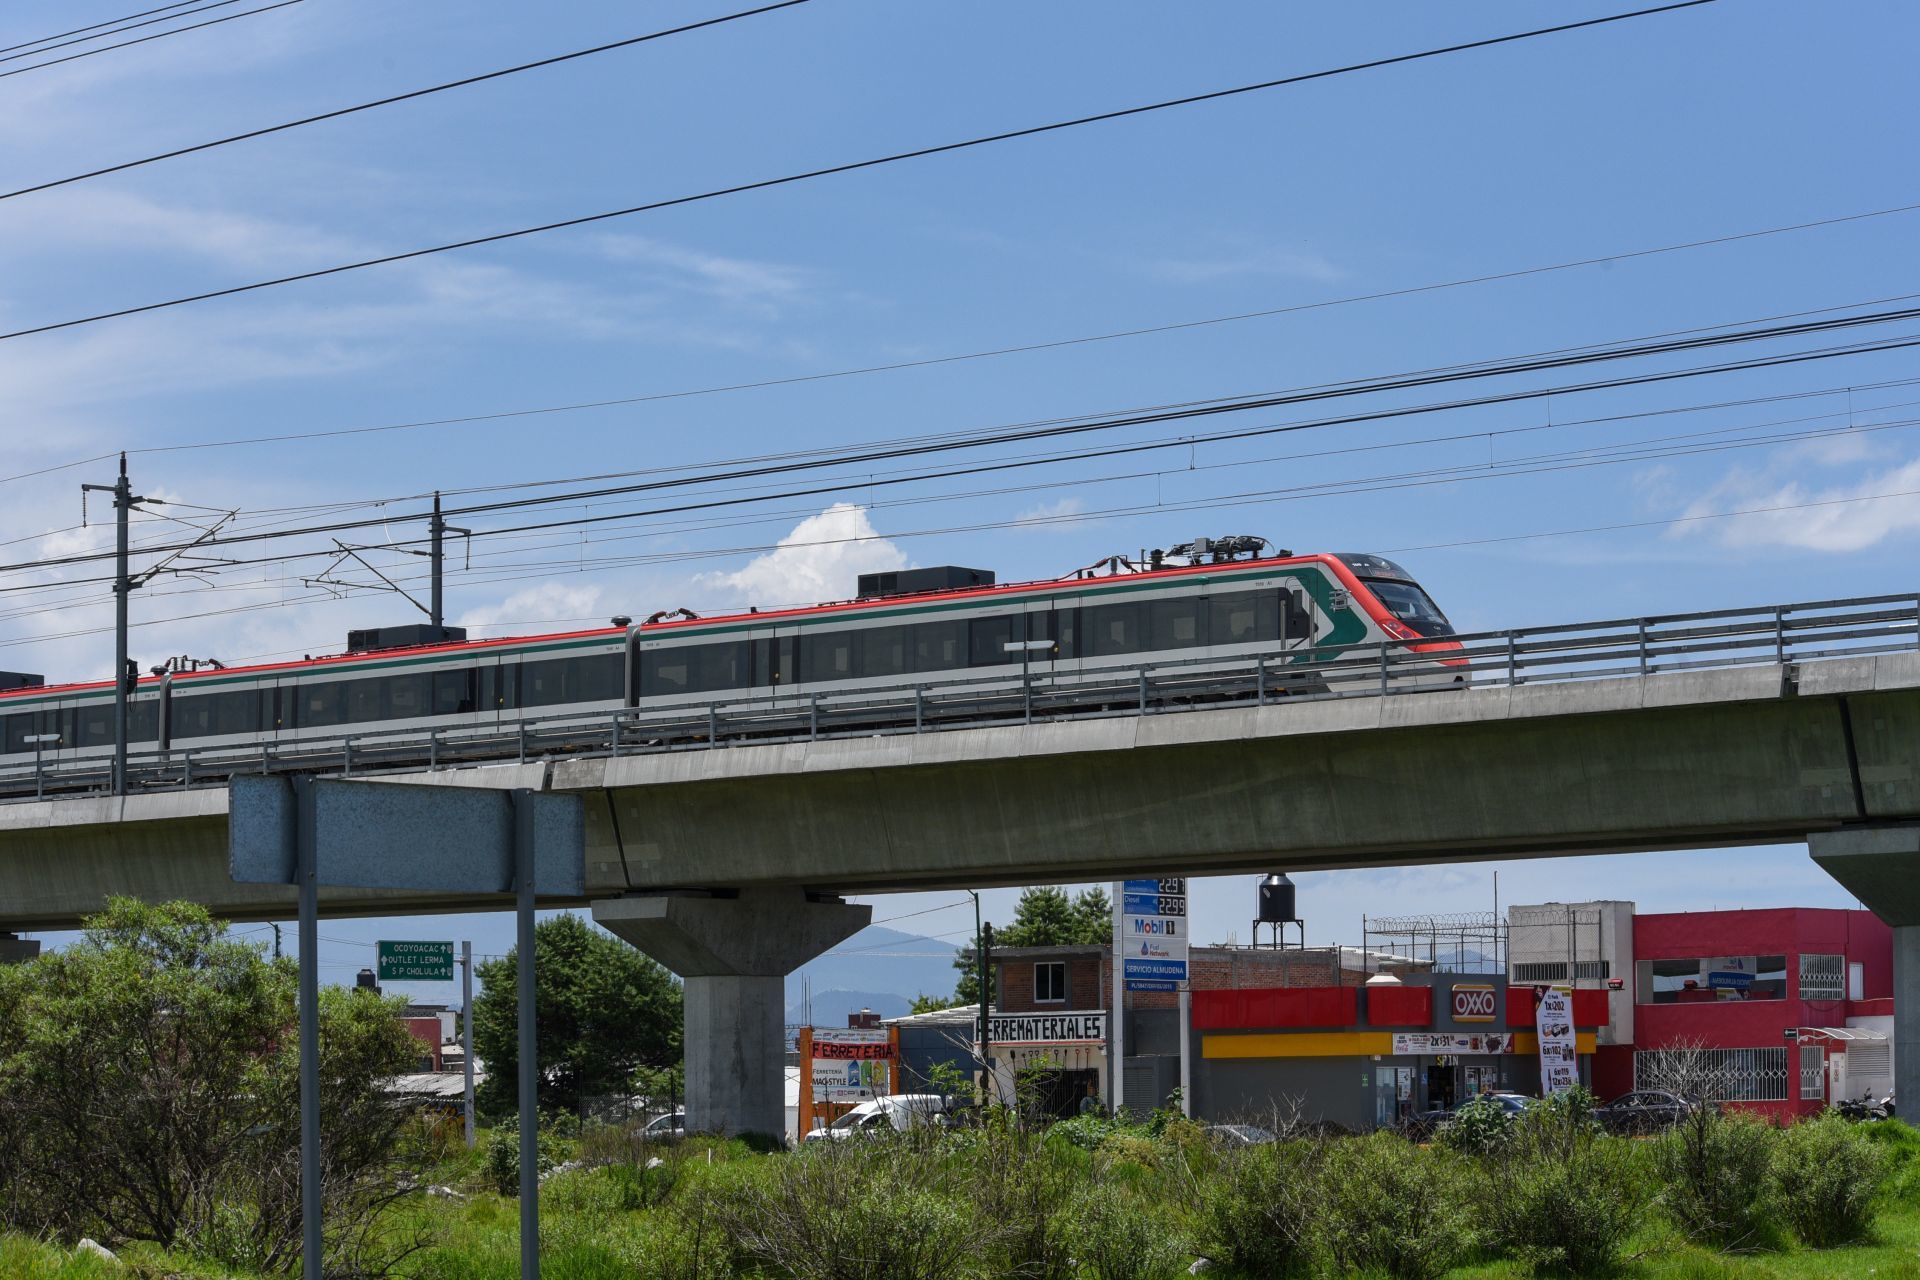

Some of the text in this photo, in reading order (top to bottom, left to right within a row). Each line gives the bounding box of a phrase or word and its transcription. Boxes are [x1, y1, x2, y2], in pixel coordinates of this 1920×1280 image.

[1159, 898, 1185, 915] 22.99
[1135, 919, 1164, 935] Mobil
[388, 955, 444, 964] OUTLET LERMA
[406, 967, 439, 976] CHOLULA
[1126, 965, 1184, 975] SERVICIO ALMUDENA
[1455, 991, 1495, 1016] OXXO
[1436, 1055, 1459, 1066] SPIN
